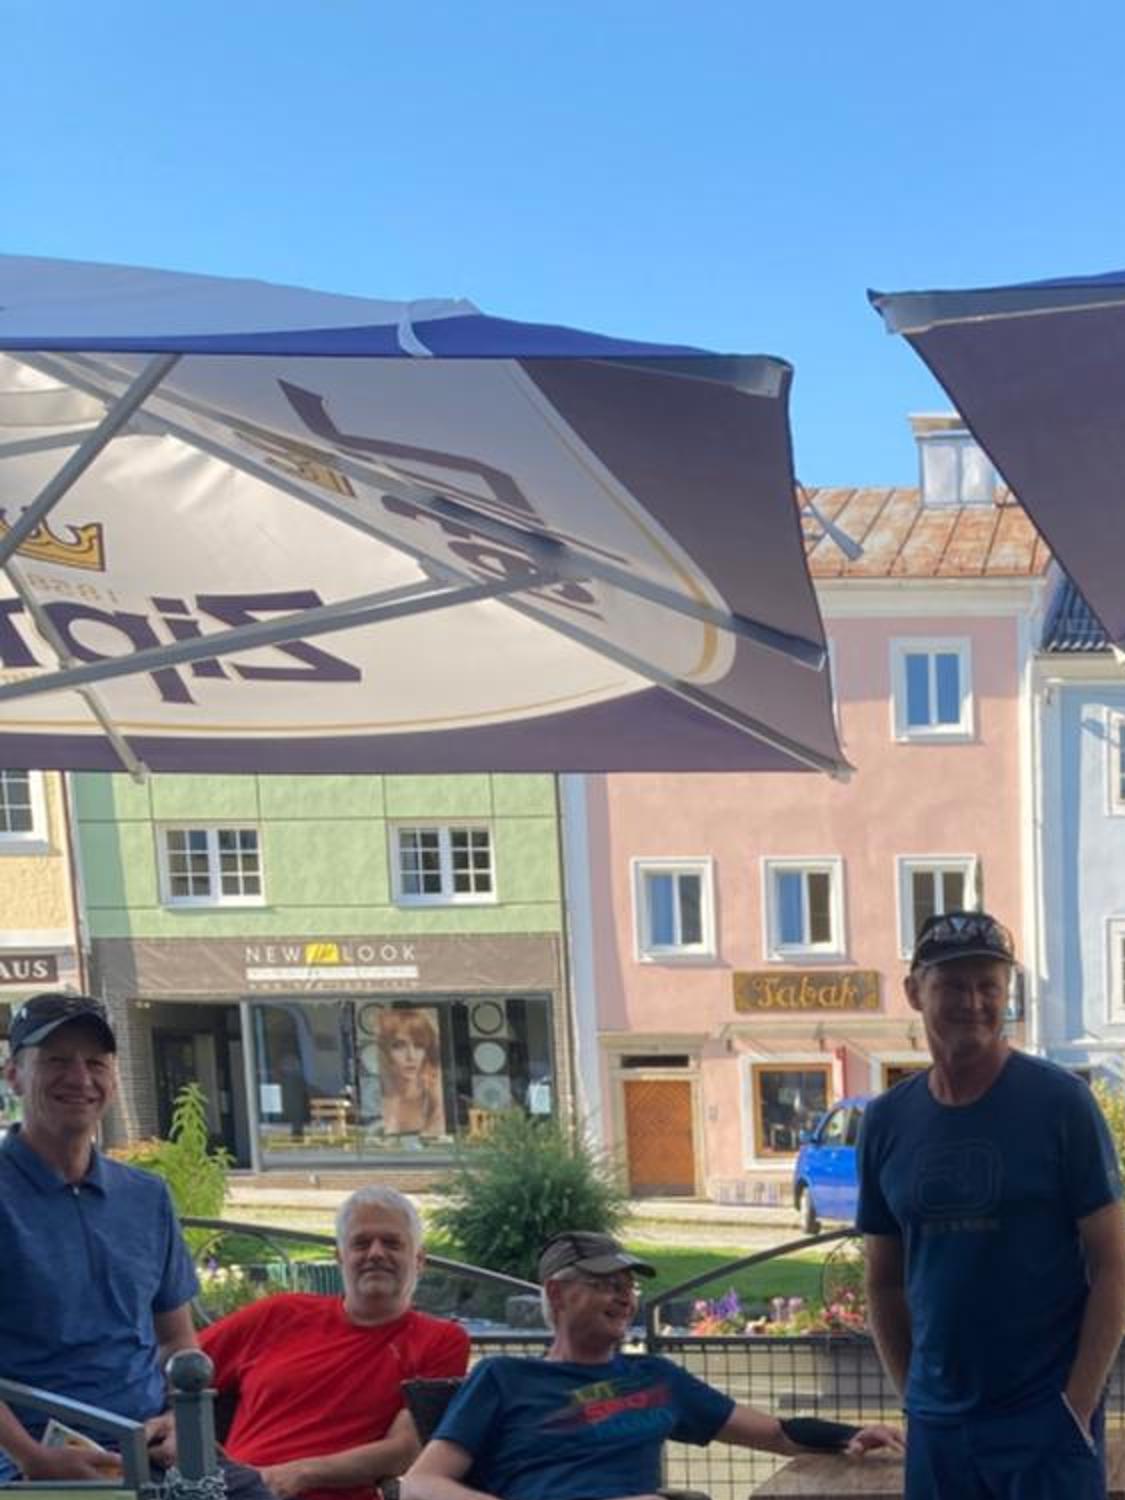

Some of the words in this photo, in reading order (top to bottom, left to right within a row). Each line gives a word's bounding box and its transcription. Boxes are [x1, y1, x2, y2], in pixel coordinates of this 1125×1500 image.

[245, 945, 300, 962] NEW
[342, 944, 415, 962] LOOK
[753, 976, 858, 1008] Tabak
